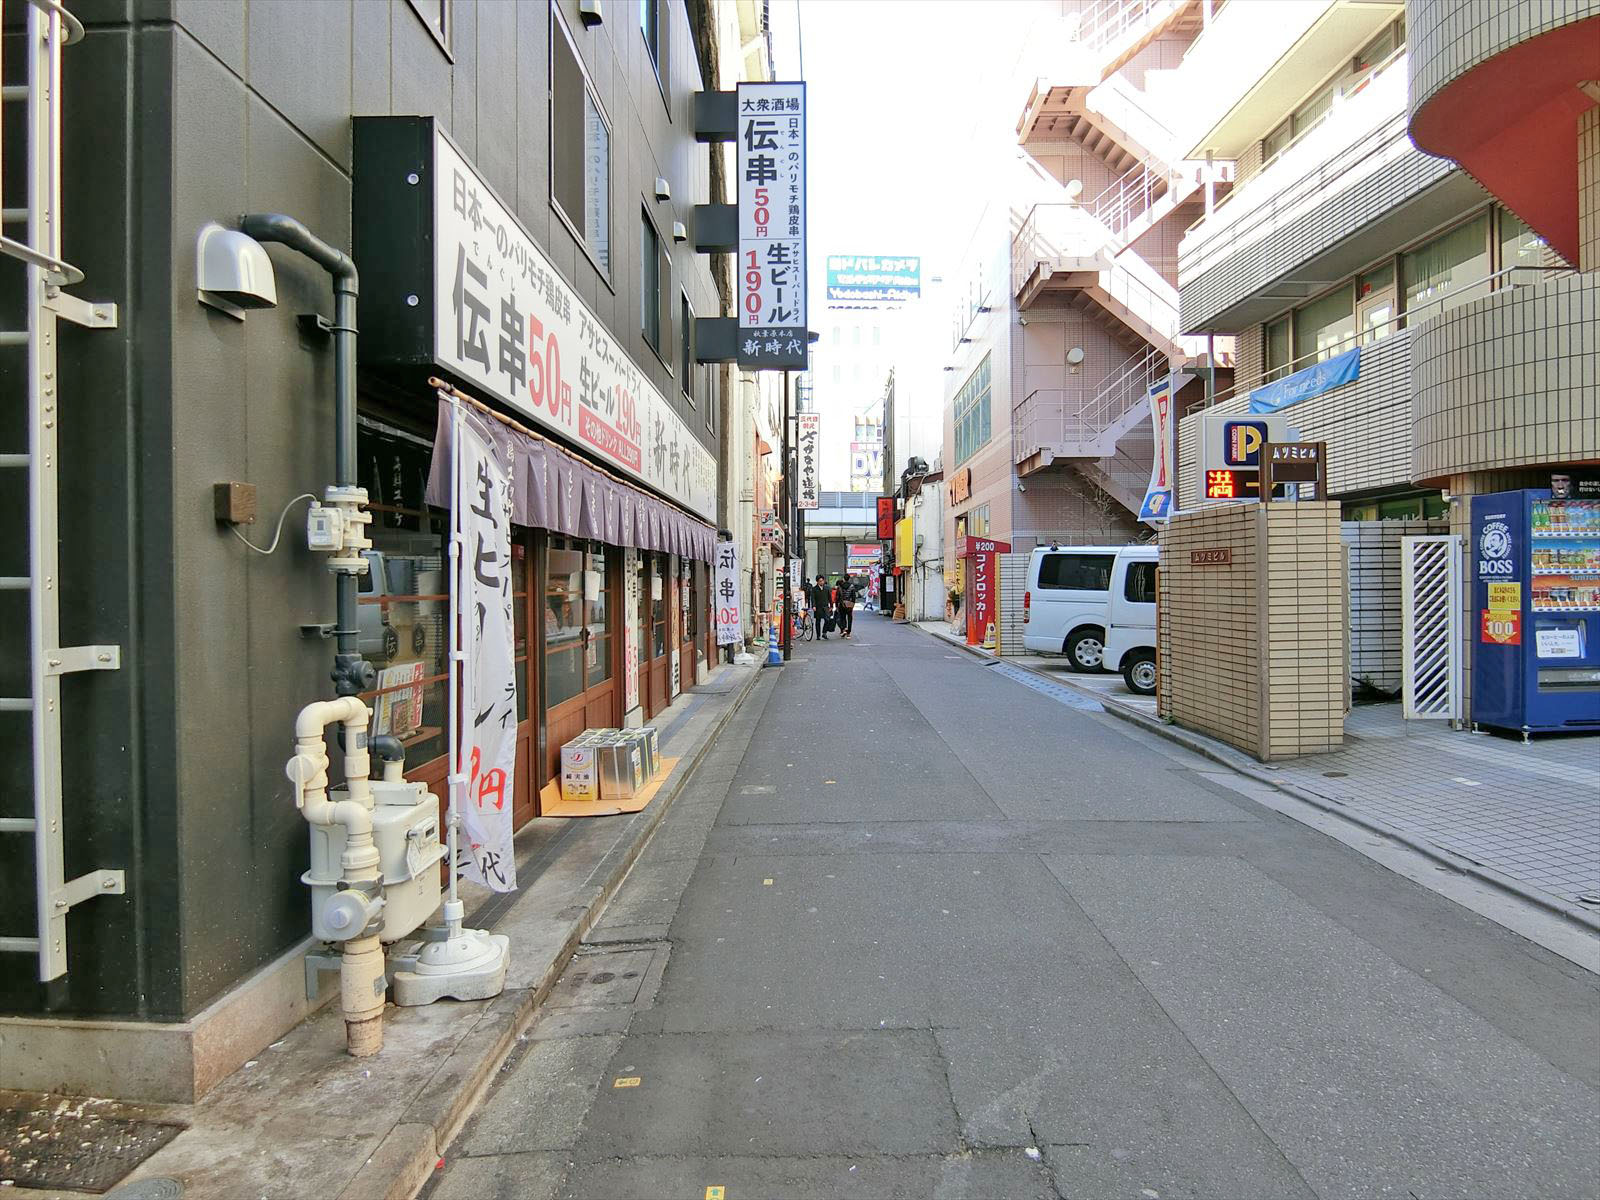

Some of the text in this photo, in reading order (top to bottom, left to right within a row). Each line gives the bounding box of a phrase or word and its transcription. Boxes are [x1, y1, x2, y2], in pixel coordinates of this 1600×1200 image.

[742, 98, 800, 112] 大衆酒場
[744, 119, 779, 237] 伝串 50円
[745, 250, 762, 325] 190円
[767, 242, 792, 324] 生ビール
[452, 241, 573, 427] 伝串 50円
[742, 338, 803, 357] 新時代
[578, 310, 642, 401] アサヒスーパードライ
[579, 355, 615, 417] 生ビール
[615, 383, 641, 447] 190円
[1237, 425, 1263, 462] P
[1272, 446, 1316, 459] ムツミビル
[1209, 471, 1233, 498] 満
[975, 541, 995, 551] ¥200
[1482, 522, 1509, 534] COFFEE
[1479, 560, 1513, 574] BOSS
[976, 554, 987, 621] コインロッカー
